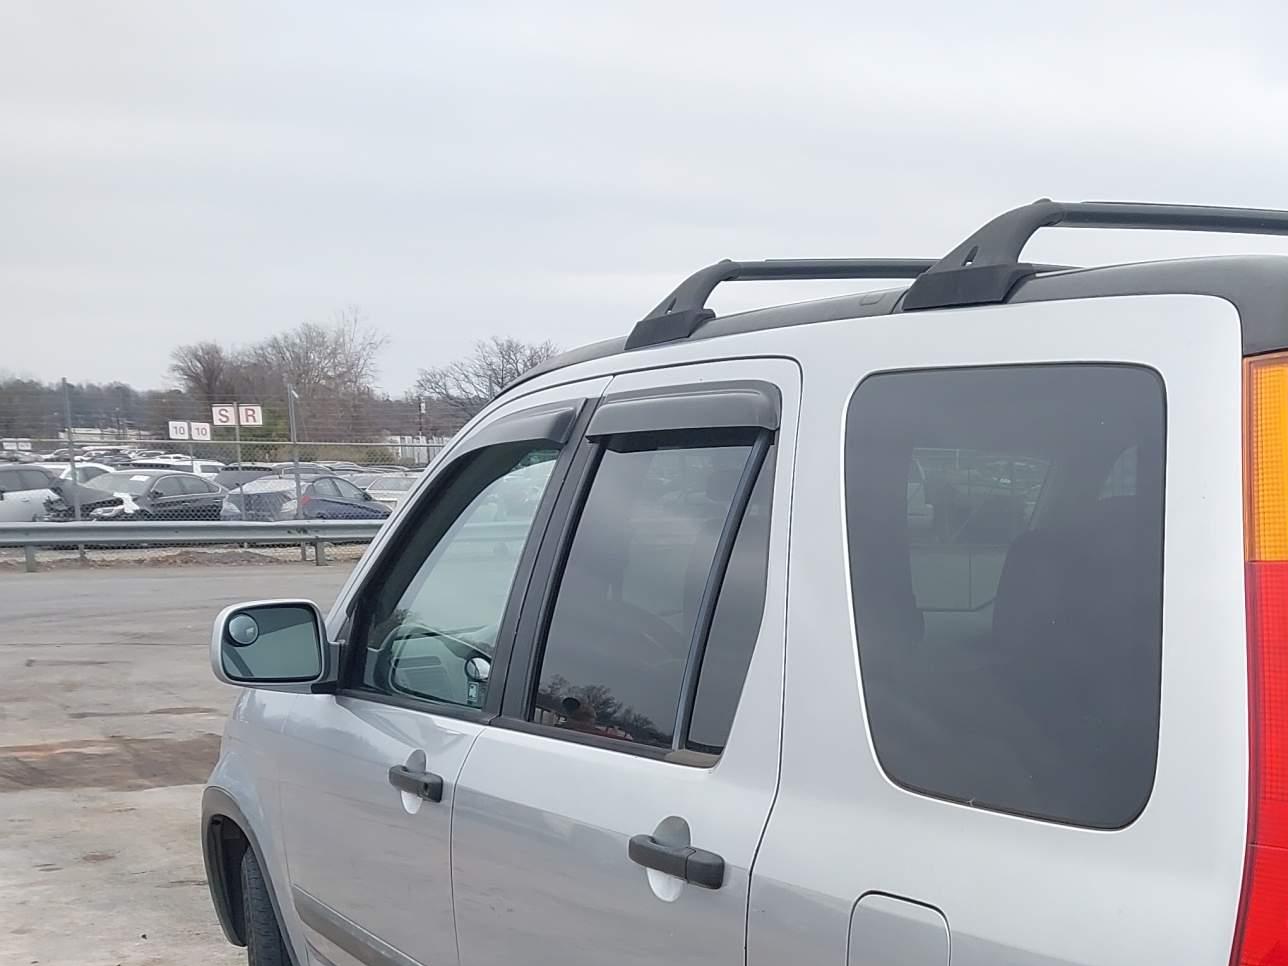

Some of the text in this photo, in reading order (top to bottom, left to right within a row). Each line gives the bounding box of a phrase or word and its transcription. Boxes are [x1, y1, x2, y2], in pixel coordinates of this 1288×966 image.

[218, 408, 230, 424] S
[244, 408, 257, 423] R
[173, 426, 185, 436] 10
[195, 427, 208, 437] 10
